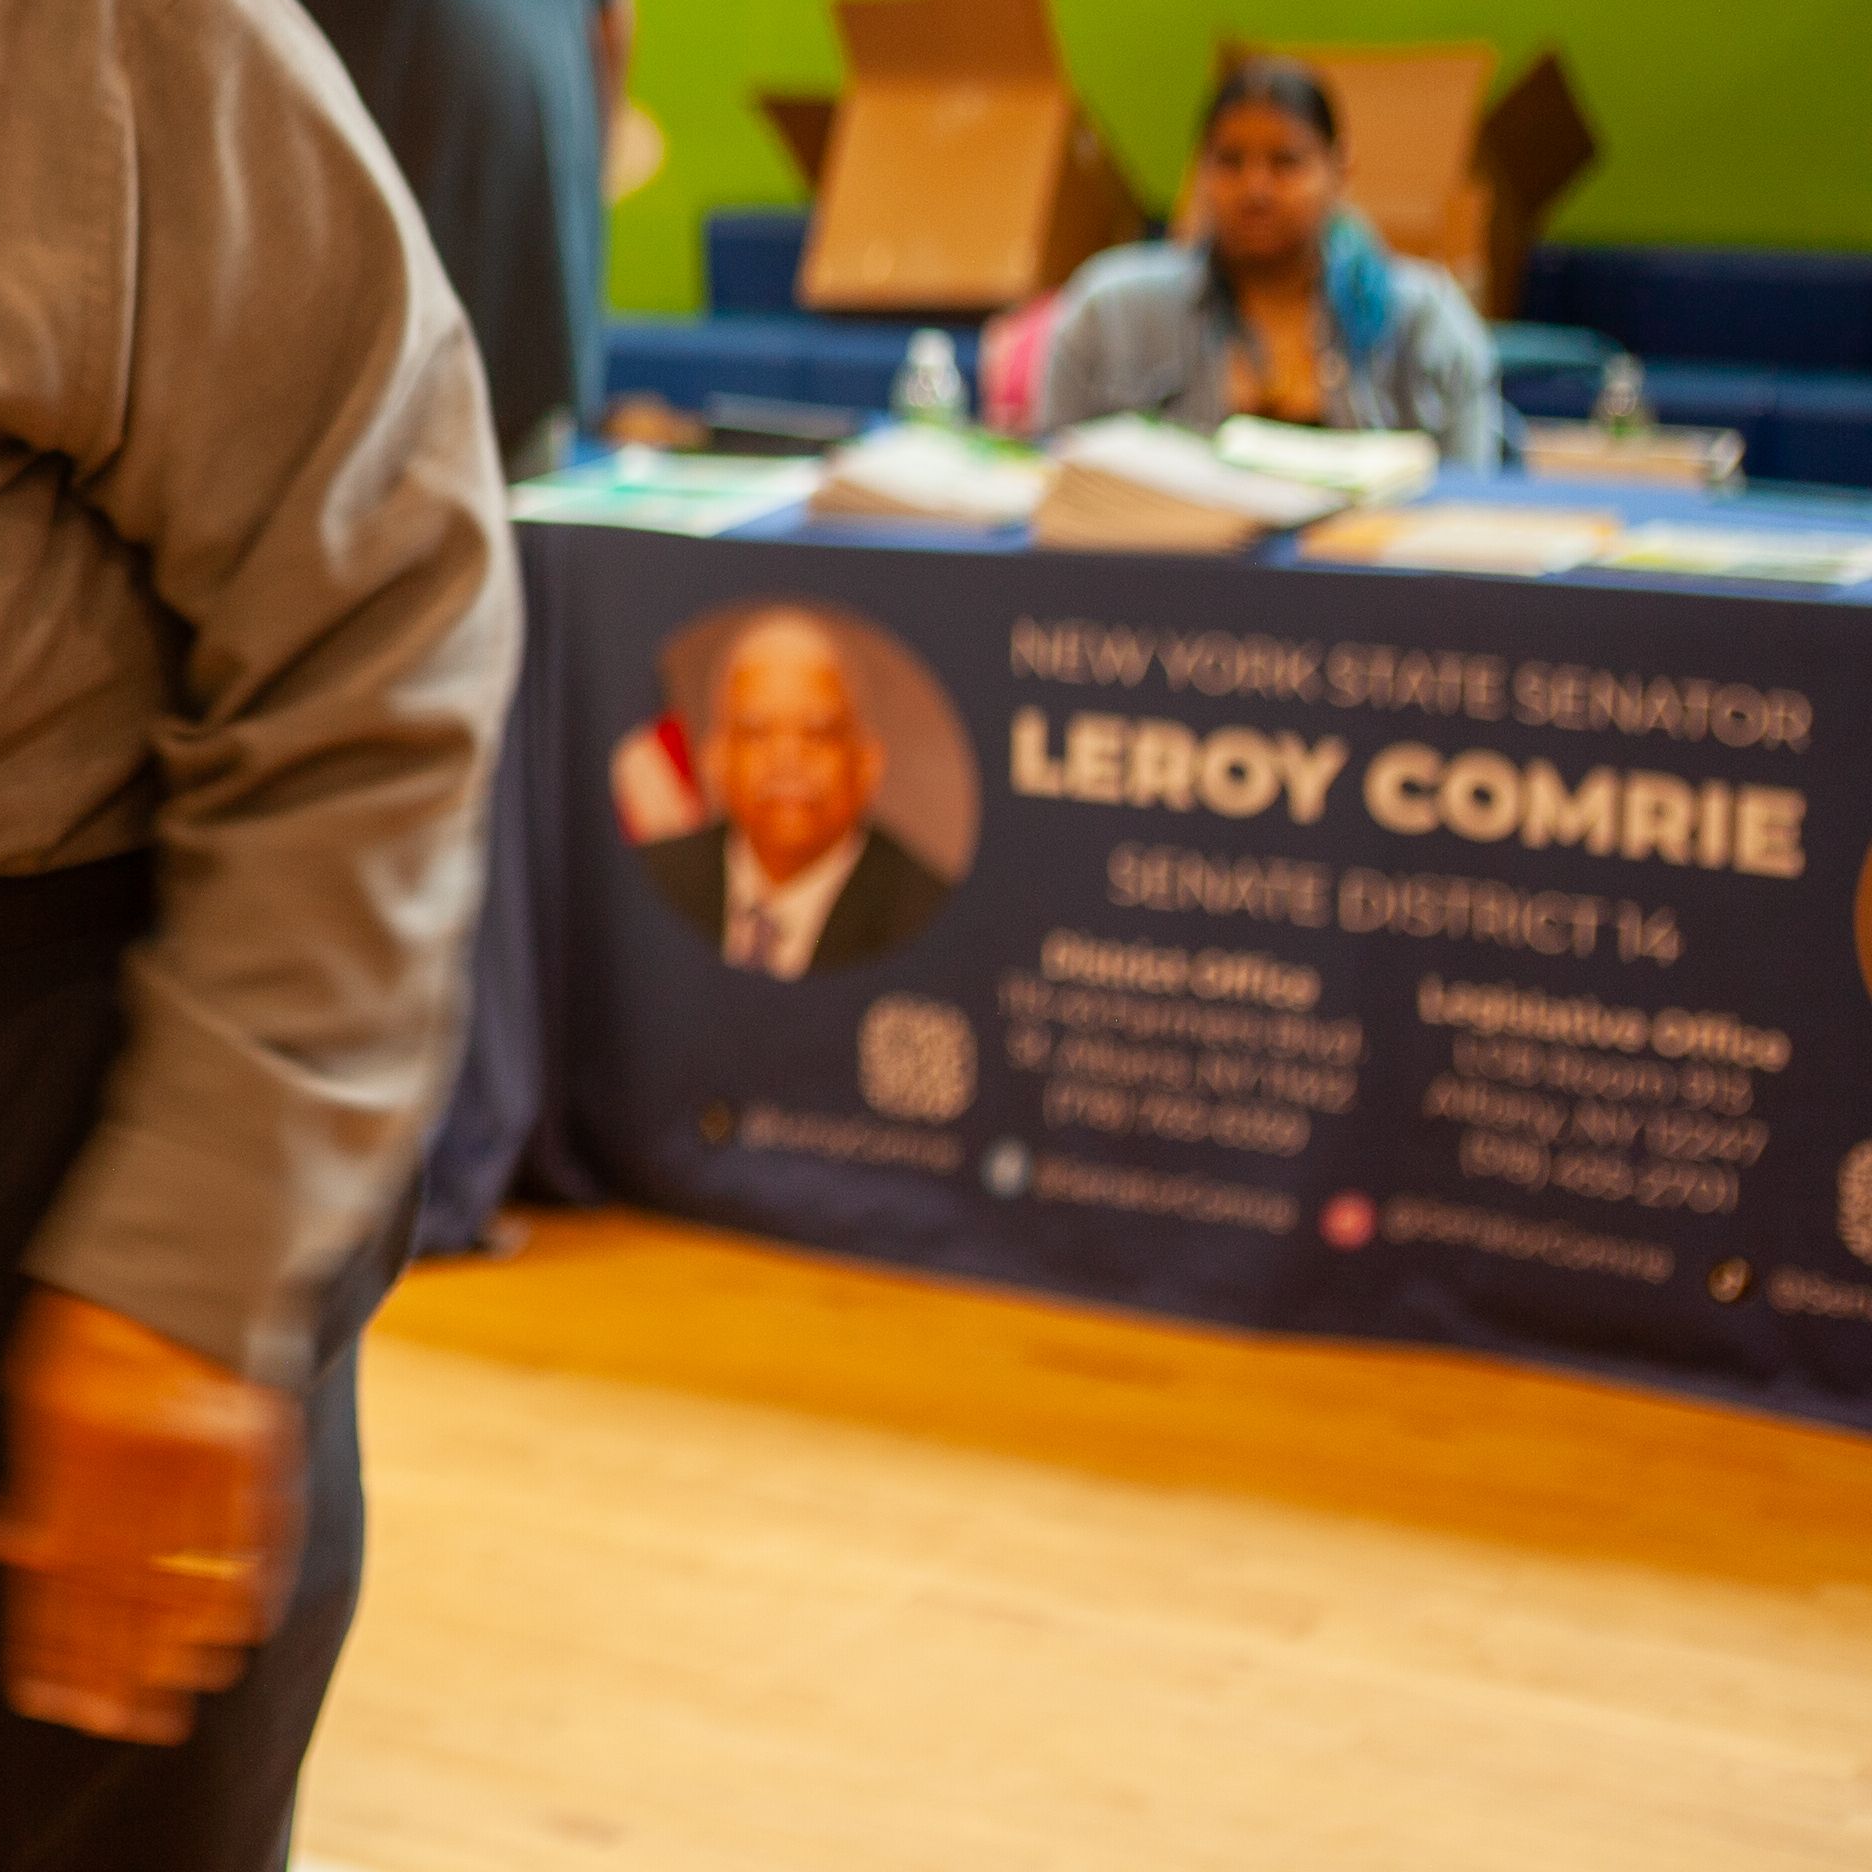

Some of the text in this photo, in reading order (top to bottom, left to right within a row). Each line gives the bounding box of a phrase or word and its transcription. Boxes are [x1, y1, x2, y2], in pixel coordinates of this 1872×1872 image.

[1012, 616, 1812, 753] NEW YORK STATE SENATOR
[1012, 705, 1807, 878] LEROY COMRIE
[1108, 842, 1683, 966] SENATE DISTRICT 14
[1193, 949, 1319, 1010] Office
[1419, 973, 1791, 1072] Legislative Office
